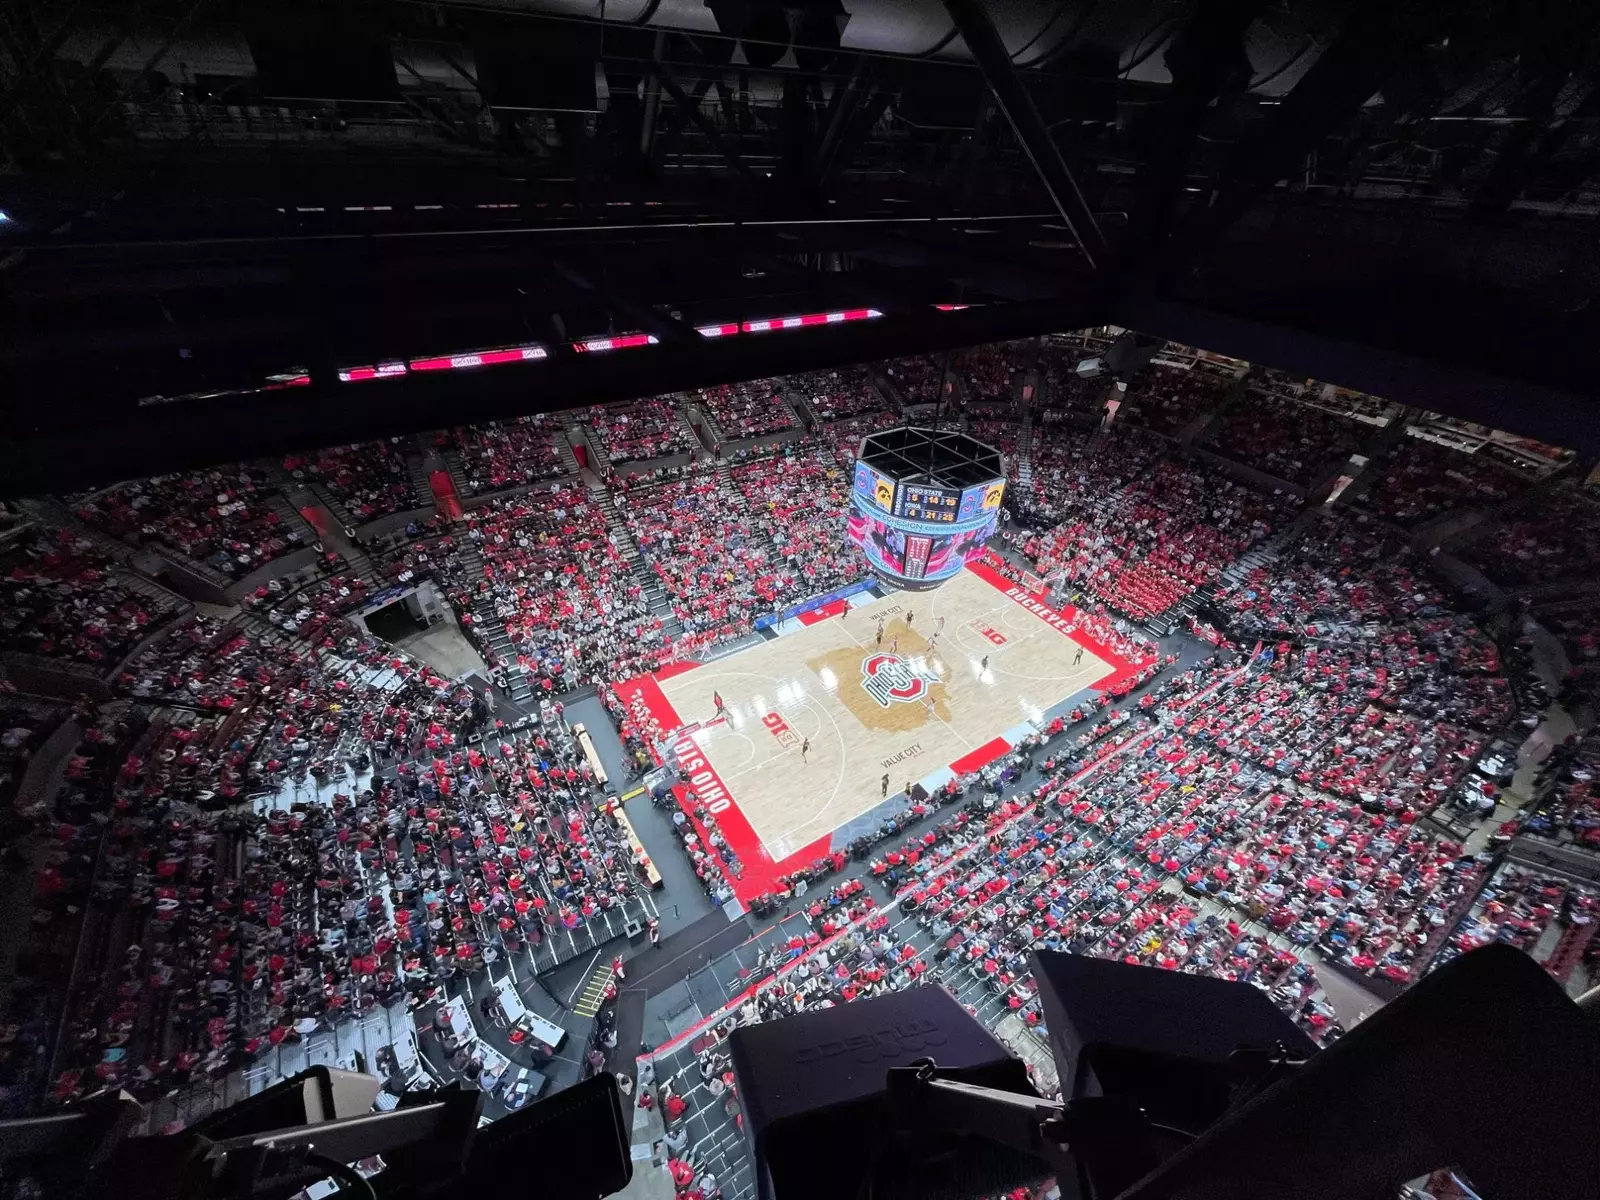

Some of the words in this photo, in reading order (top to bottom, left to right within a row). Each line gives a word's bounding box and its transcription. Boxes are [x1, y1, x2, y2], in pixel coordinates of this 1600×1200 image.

[882, 514, 923, 529] COHESION
[909, 508, 916, 516] 4
[869, 609, 889, 621] VALUE
[888, 605, 902, 614] CITY
[1005, 588, 1077, 634] BUCKEYES
[880, 751, 907, 768] VALUE
[903, 742, 922, 757] CITY
[691, 771, 731, 814] OHIO
